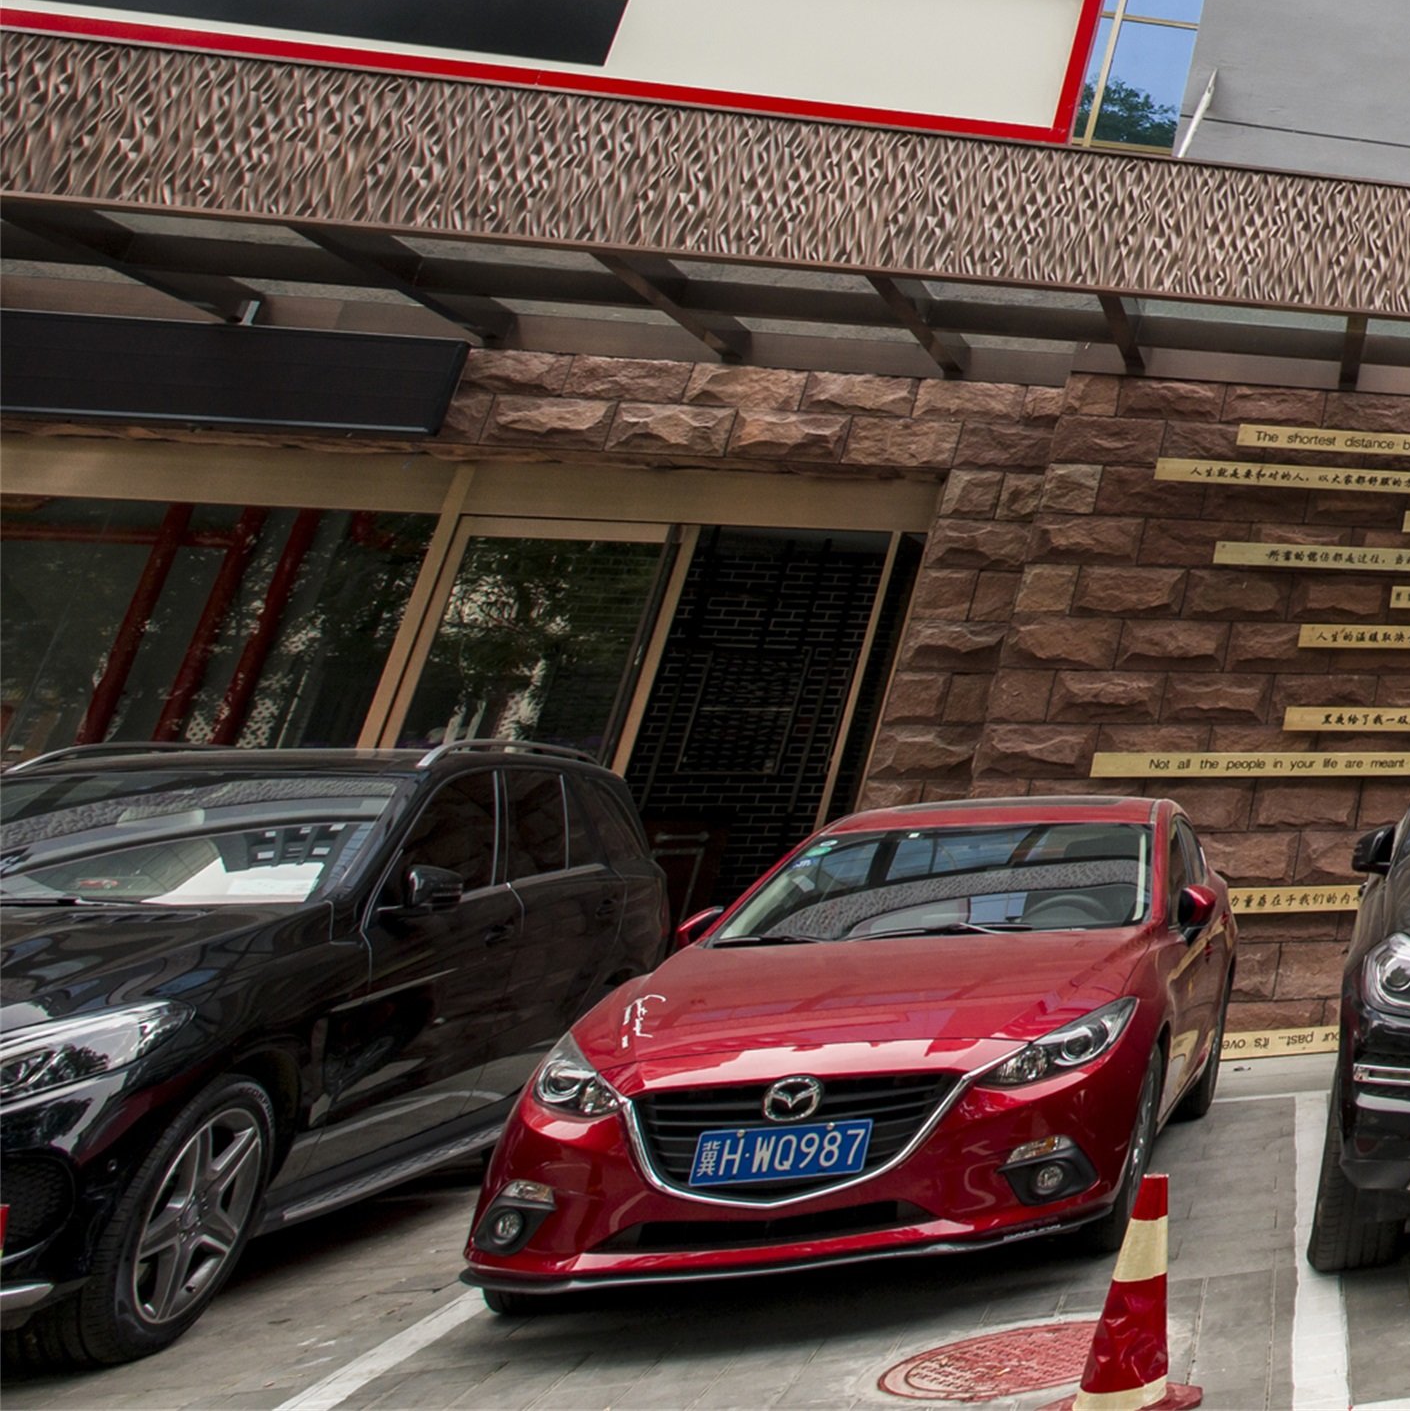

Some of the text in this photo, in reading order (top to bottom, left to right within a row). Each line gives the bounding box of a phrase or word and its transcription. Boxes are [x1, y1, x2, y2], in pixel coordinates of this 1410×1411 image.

[1256, 431, 1279, 443] The
[1287, 432, 1337, 445] shortest
[1344, 436, 1395, 449] distance
[1395, 592, 1402, 602] If
[1149, 759, 1170, 770] Not
[1177, 758, 1191, 769] all
[1200, 758, 1219, 769] the
[1226, 759, 1266, 771] people
[1273, 758, 1283, 769] in
[1290, 759, 1315, 771] your
[1323, 757, 1338, 769] life
[1345, 760, 1364, 769] are
[1370, 758, 1405, 768] meant
[1222, 1039, 1247, 1050] ove
